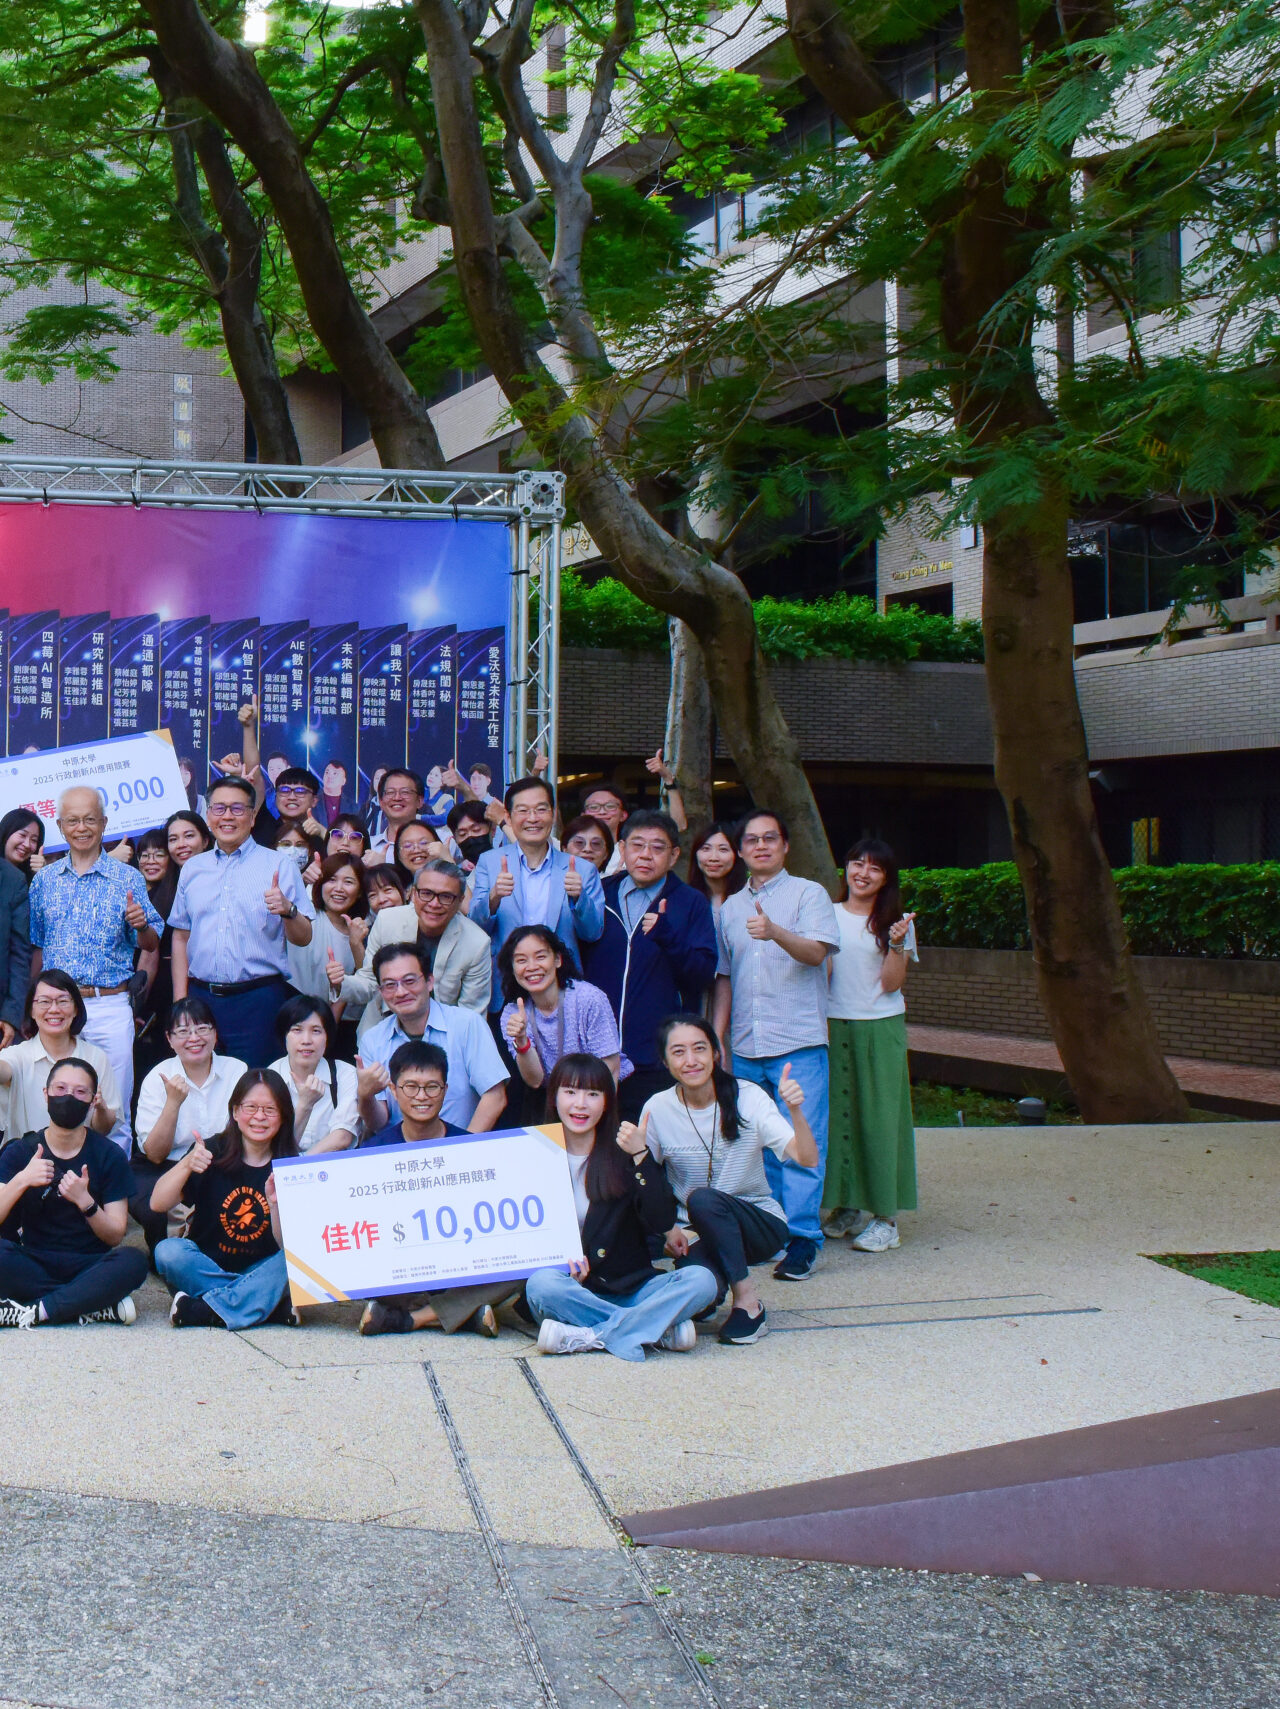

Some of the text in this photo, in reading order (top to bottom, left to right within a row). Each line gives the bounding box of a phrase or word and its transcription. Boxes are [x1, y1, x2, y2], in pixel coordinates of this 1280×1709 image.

[40, 631, 54, 720] 四莓AI智造所
[91, 632, 104, 706] 研究推推組
[141, 634, 154, 693] 通通都隊
[241, 639, 254, 696] AI智工隊
[290, 640, 305, 711] AIE數智幫手
[341, 642, 353, 715] 未來編輯部
[390, 643, 403, 702] 讓我下班
[487, 646, 501, 748] 愛沃克未來工作室
[33, 774, 54, 786] 2025
[62, 753, 97, 767] 中原大學
[348, 1168, 497, 1198] 2025 行政創新AI應用競賽
[394, 1156, 446, 1174] 中原大學
[321, 1220, 381, 1254] 佳作
